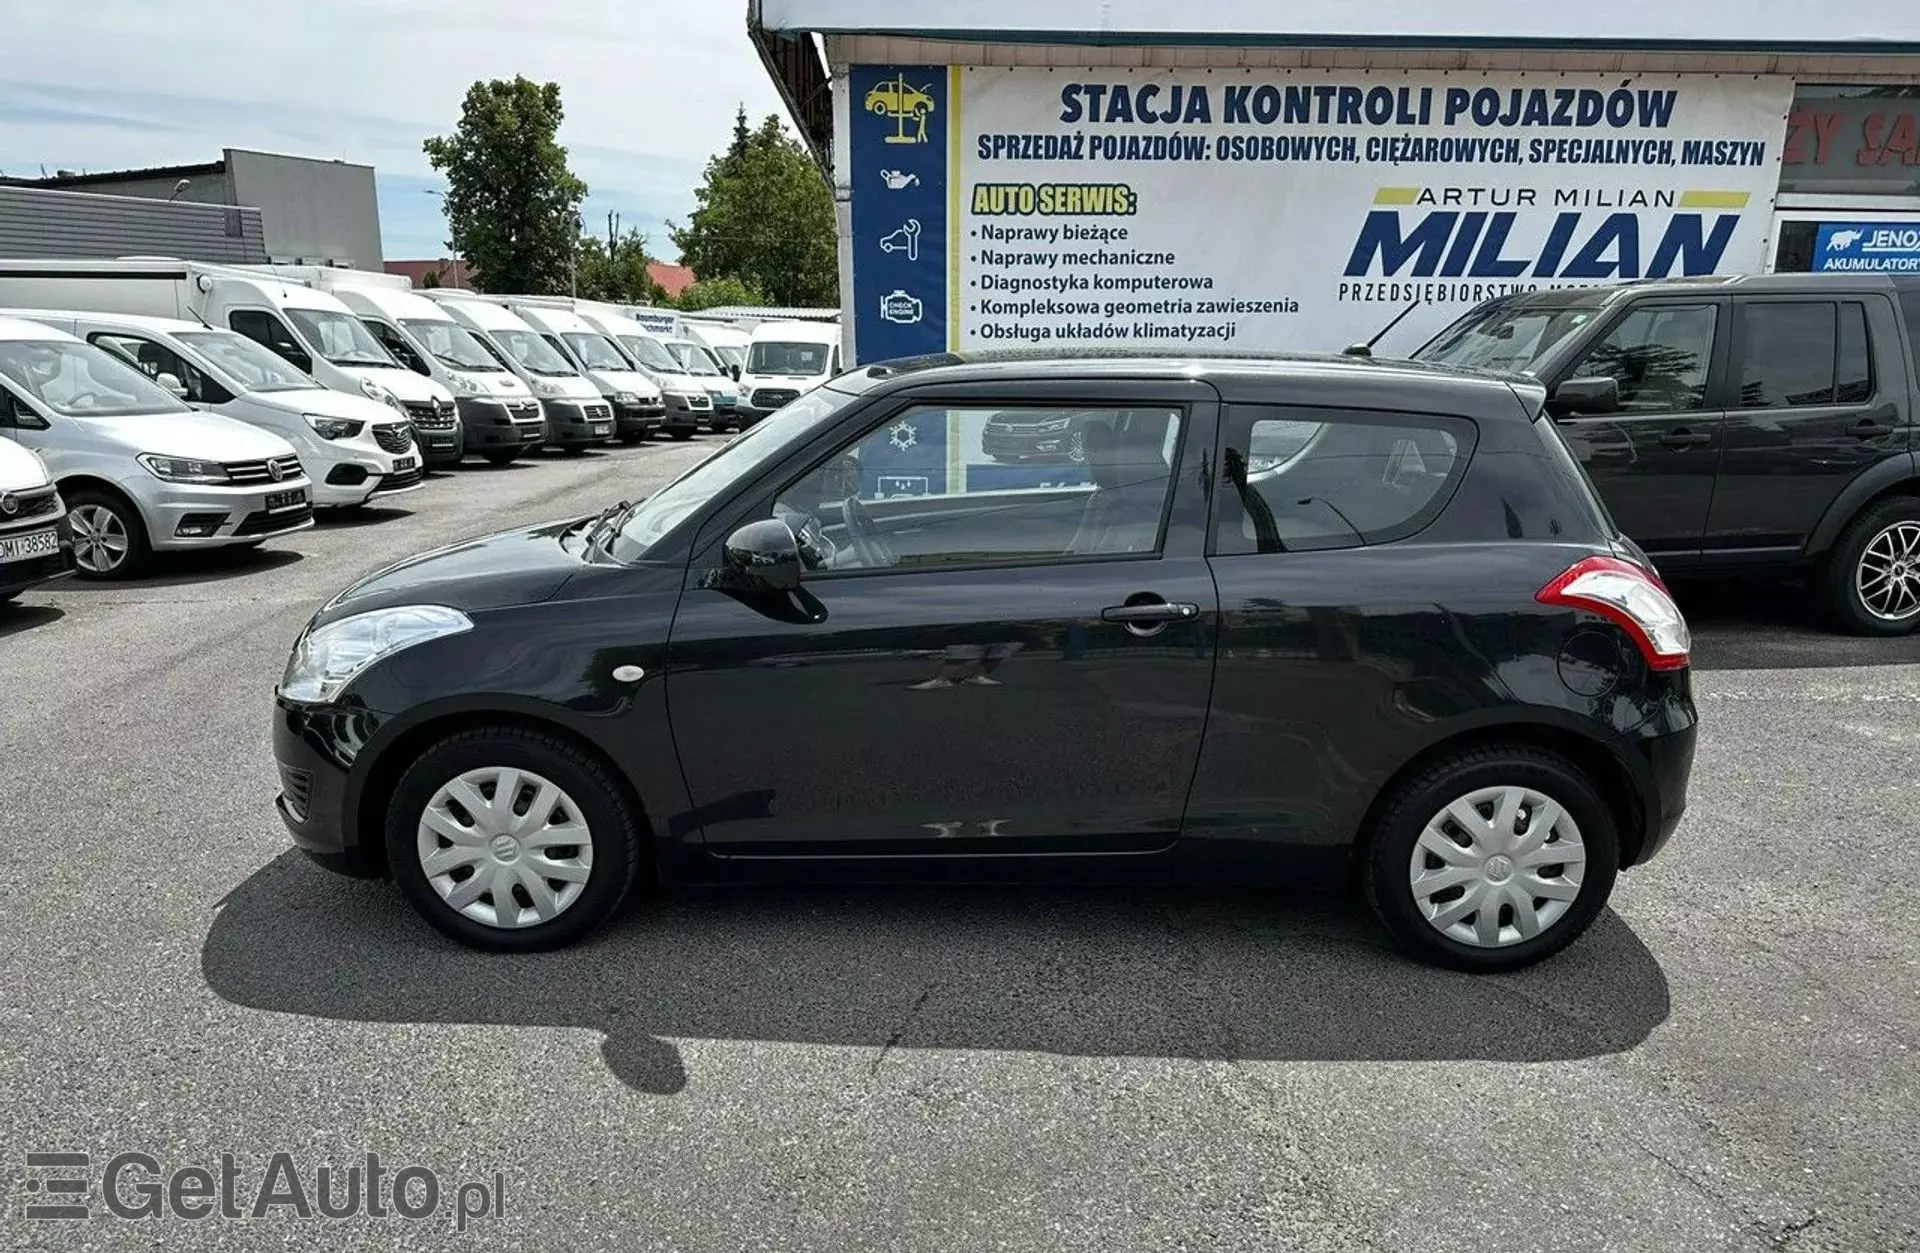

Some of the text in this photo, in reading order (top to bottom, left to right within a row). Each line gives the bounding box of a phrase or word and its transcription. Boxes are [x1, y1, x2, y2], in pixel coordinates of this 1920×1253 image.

[1060, 79, 1679, 128] STACJA KONTROLI POJAZDÓW
[978, 131, 1766, 168] SPRZEDAŻ POJAZDÓW: OSOBOWYCH, CIĘŻAROWYCH, SPECJALNYCH, MASZYN
[1856, 112, 1920, 166] SA
[972, 183, 1138, 216] AUTO SERWIS:
[1416, 187, 1675, 208] ARTUR MILIAN
[981, 224, 1129, 245] Naprawy bieżące
[1343, 210, 1741, 278] MILIAN
[981, 249, 1176, 270] Naprawy mechaniczne
[1824, 258, 1920, 270] AKUMULATOR
[981, 274, 1214, 294] Diagnostyka komputerowa
[981, 297, 1299, 319] Kompleksowa geometria zawieszenia
[980, 321, 1236, 343] Obsługa układów klimatyzacji
[24, 532, 57, 553] 38582
